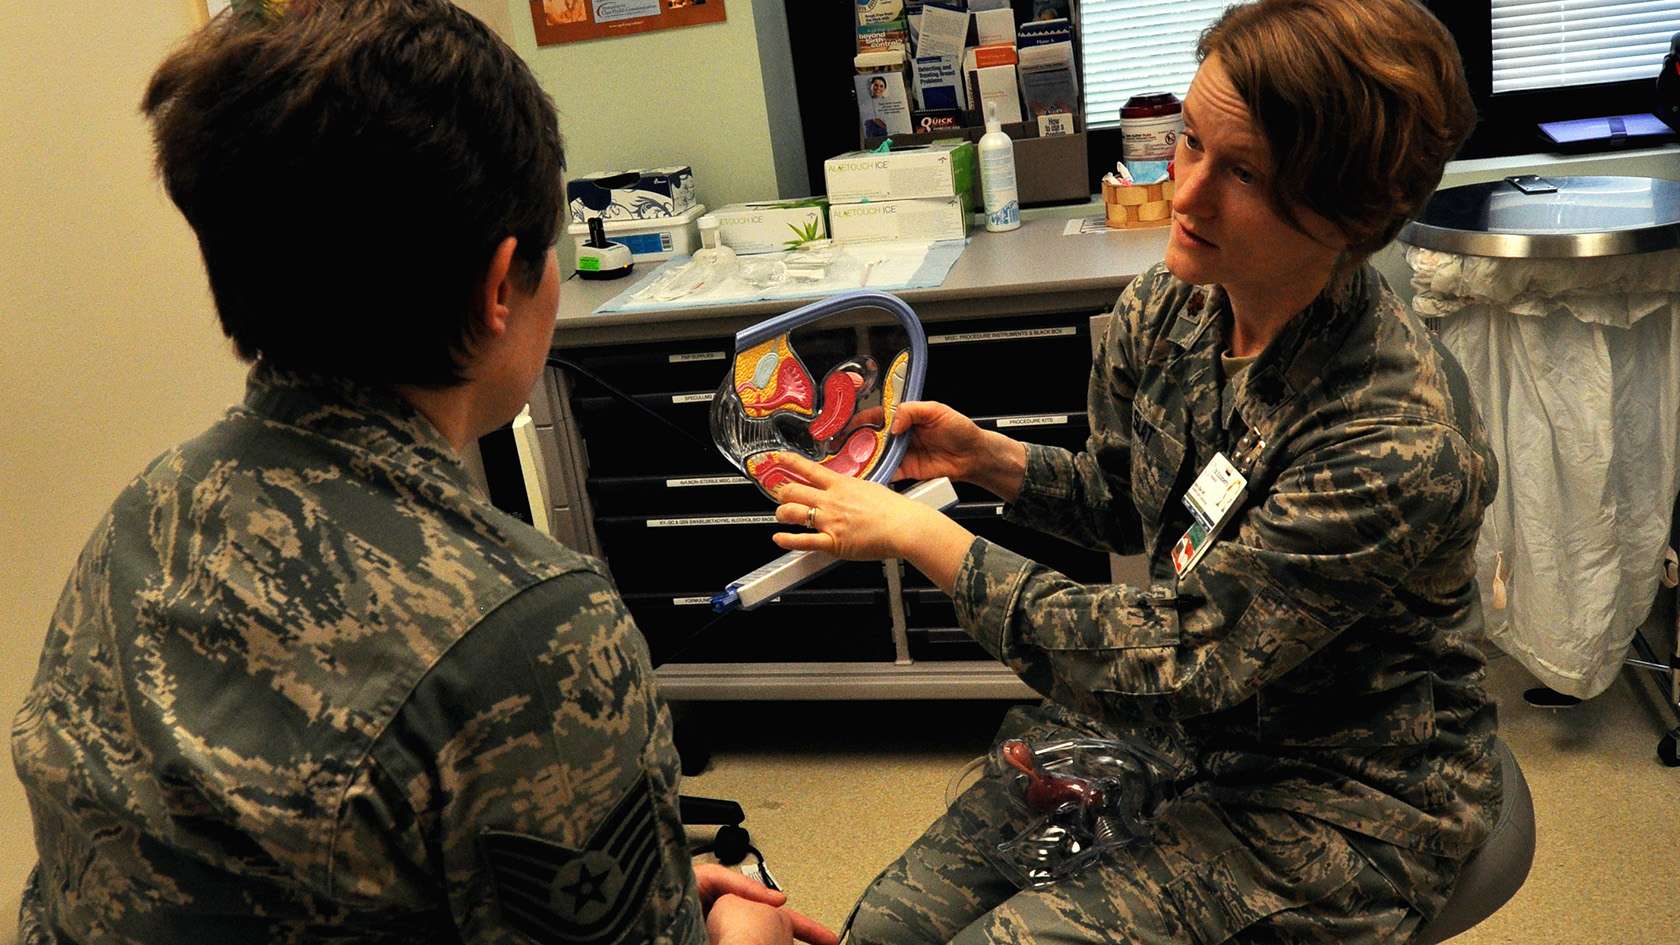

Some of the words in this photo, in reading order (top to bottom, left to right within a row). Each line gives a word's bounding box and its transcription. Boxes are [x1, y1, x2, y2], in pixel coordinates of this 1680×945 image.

[875, 161, 888, 169] ICE
[882, 206, 896, 214] ICE
[751, 216, 763, 224] ICE
